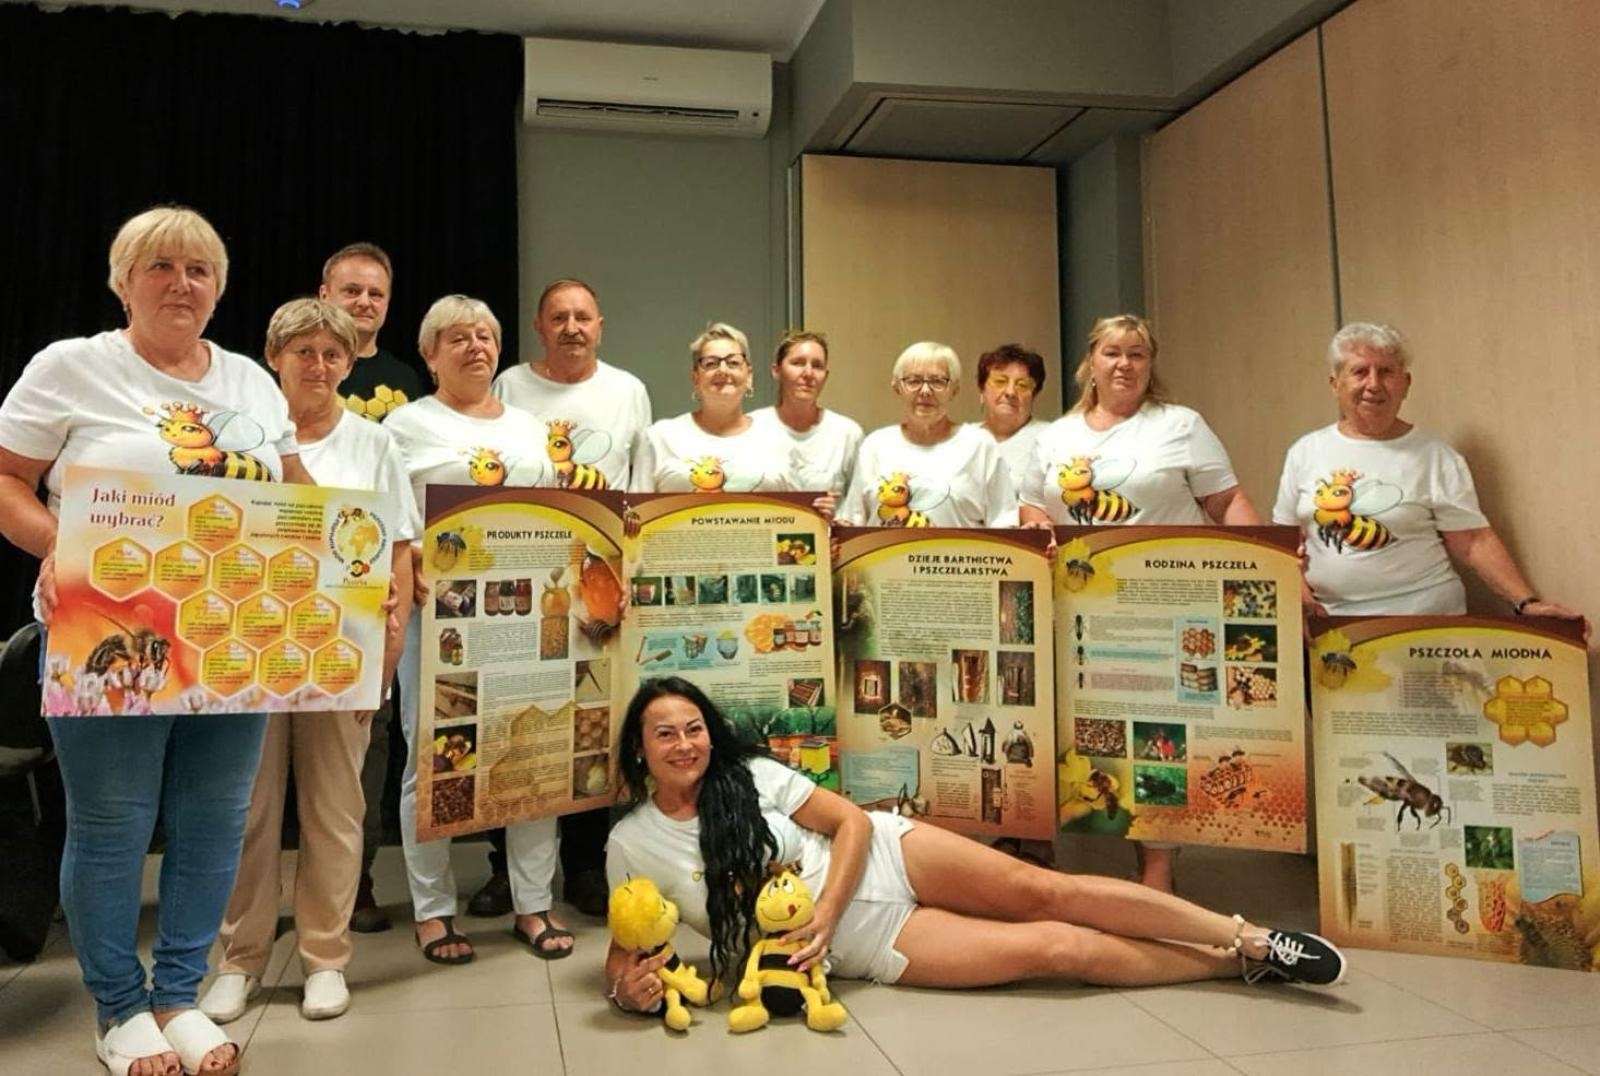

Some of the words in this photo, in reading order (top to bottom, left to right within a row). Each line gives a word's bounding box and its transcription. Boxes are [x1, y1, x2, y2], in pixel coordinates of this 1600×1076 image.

[92, 488, 127, 503] Jaki
[132, 492, 176, 507] miód
[90, 512, 164, 528] wybrać?
[691, 516, 760, 525] POWSTAWANIE
[764, 516, 795, 524] MIODU
[487, 530, 532, 539] PRODUKTY
[534, 530, 572, 539] PSZCZELE
[908, 555, 941, 563] DZIEJE
[943, 555, 1013, 565] BARTNICTWA
[1145, 560, 1196, 569] RODZINA
[1202, 560, 1257, 570] PSZCZELA
[920, 566, 1008, 576] PSZCZELARSTWA
[1409, 647, 1482, 658] PSZCZOŁA
[1491, 648, 1552, 659] MIODNA
